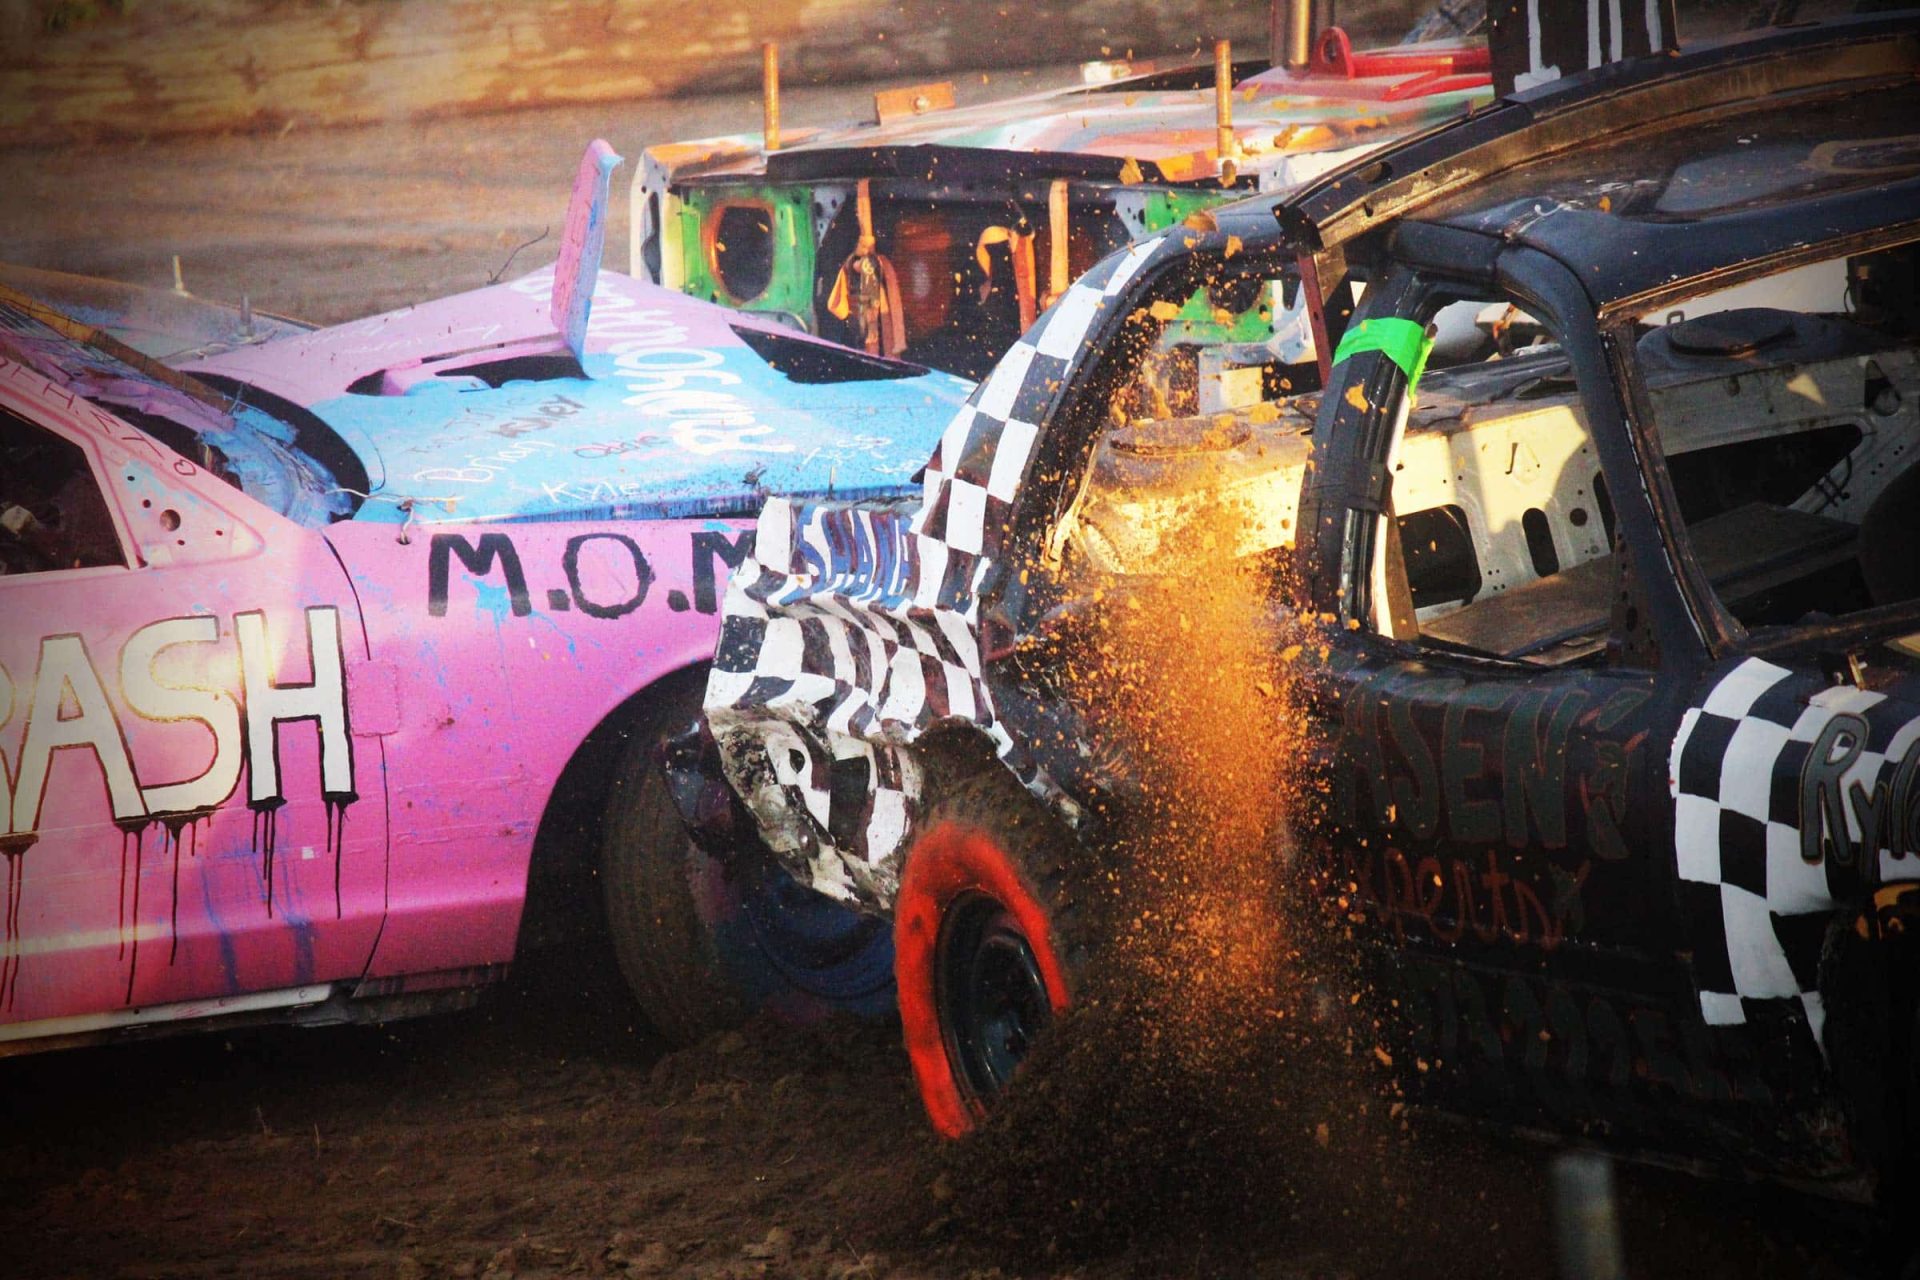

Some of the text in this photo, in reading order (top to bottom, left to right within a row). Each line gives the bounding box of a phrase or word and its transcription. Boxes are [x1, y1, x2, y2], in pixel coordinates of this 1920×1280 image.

[413, 439, 557, 483] Brian
[541, 479, 642, 503] Kyle
[0, 604, 359, 843] ASH
